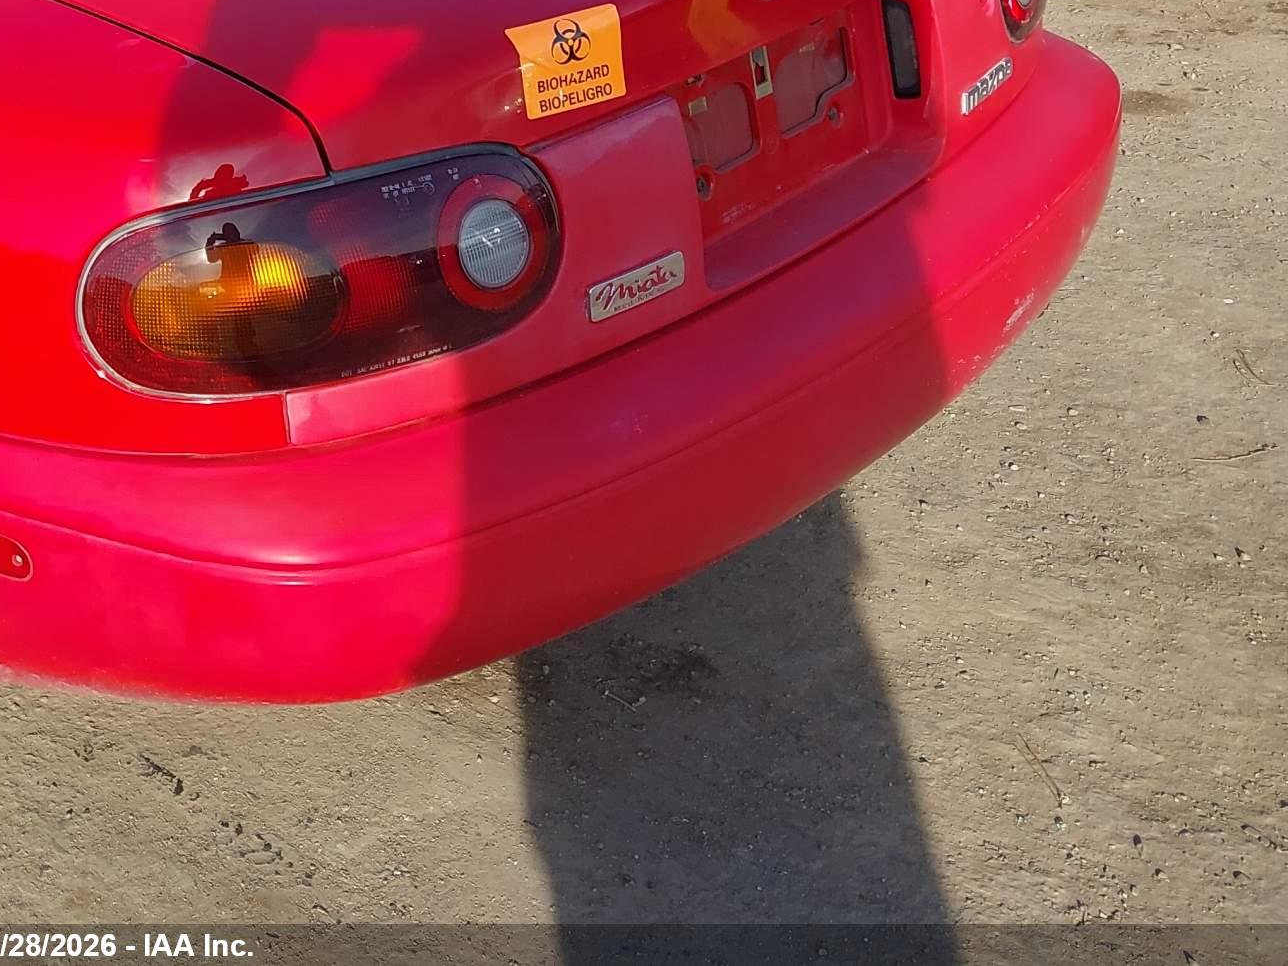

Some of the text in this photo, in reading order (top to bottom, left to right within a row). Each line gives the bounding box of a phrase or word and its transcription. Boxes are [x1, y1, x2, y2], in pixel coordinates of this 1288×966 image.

[537, 64, 610, 94] BIOHAZARD
[539, 82, 613, 113] BIOPELIGRO
[595, 265, 678, 311] Miata
